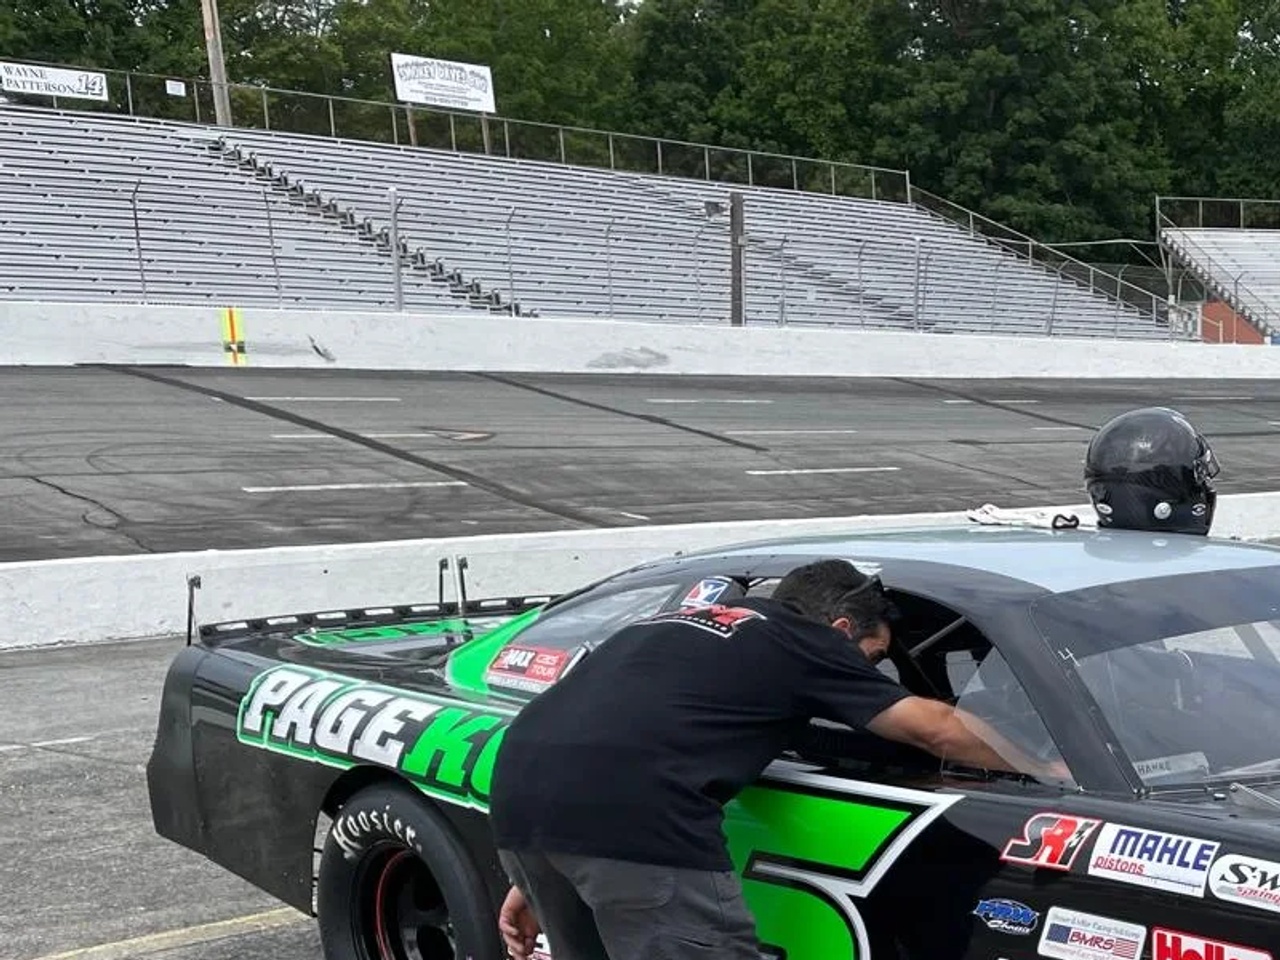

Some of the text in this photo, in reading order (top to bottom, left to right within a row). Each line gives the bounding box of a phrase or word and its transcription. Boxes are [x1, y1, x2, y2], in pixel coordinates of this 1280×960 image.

[3, 65, 46, 79] WAYNE
[6, 78, 76, 94] PATTERSON
[76, 73, 104, 96] 14
[332, 804, 422, 858] Hoosier
[1110, 829, 1215, 873] MAHLE
[1092, 856, 1146, 875] pistons
[1069, 931, 1115, 951] BMRS
